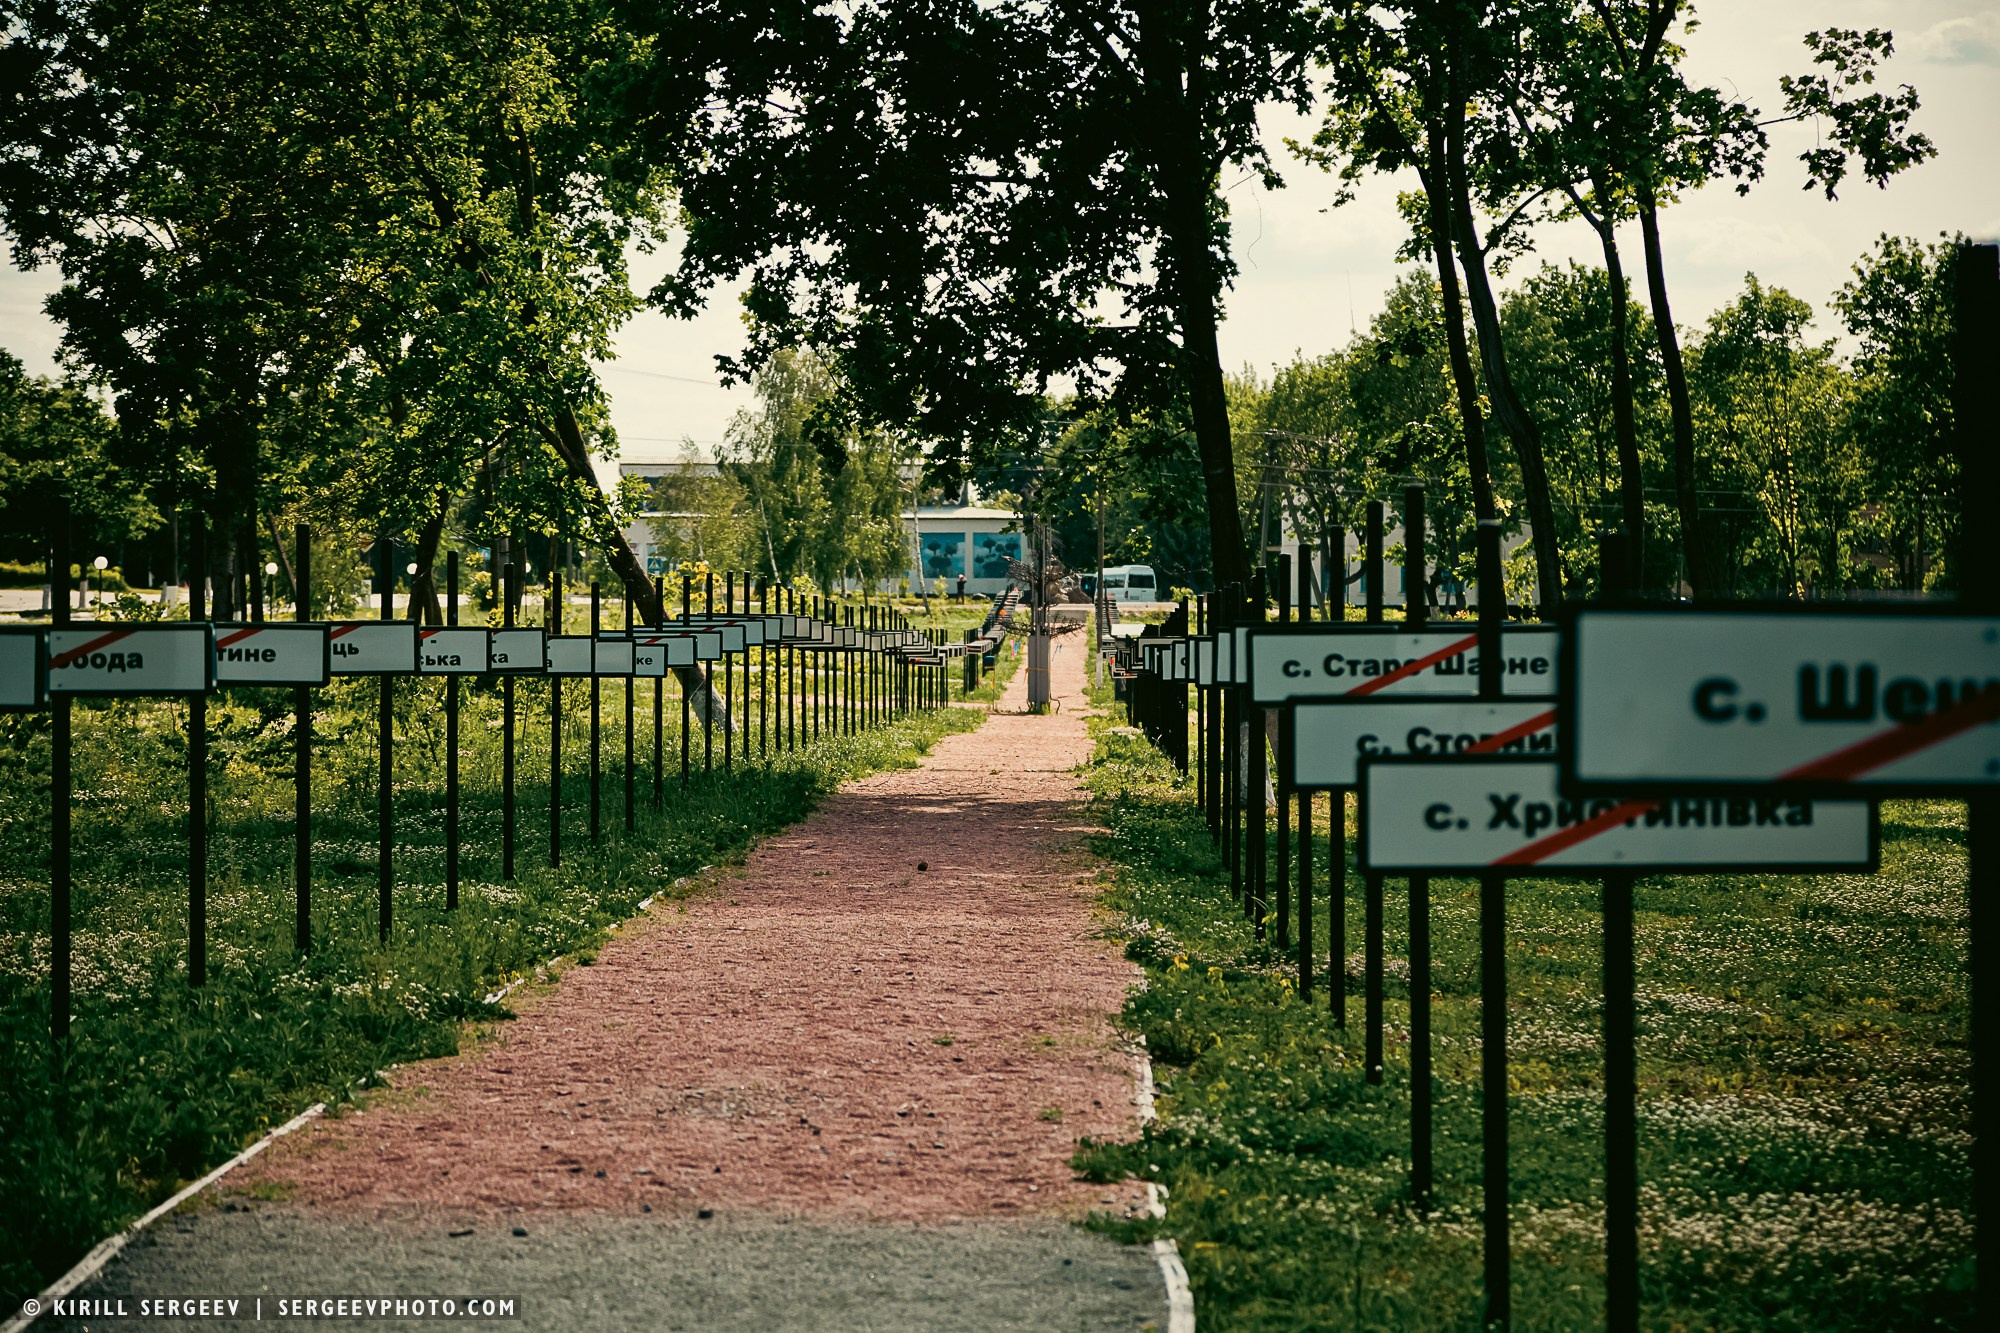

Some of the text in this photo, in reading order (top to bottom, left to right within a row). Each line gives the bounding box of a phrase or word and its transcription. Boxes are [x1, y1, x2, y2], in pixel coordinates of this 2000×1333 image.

[333, 643, 359, 657] ць
[1282, 659, 1311, 677] с.
[1434, 652, 1549, 676] Шане
[1692, 677, 1766, 723] с.
[1424, 794, 1813, 837] с. Хрисинівка
